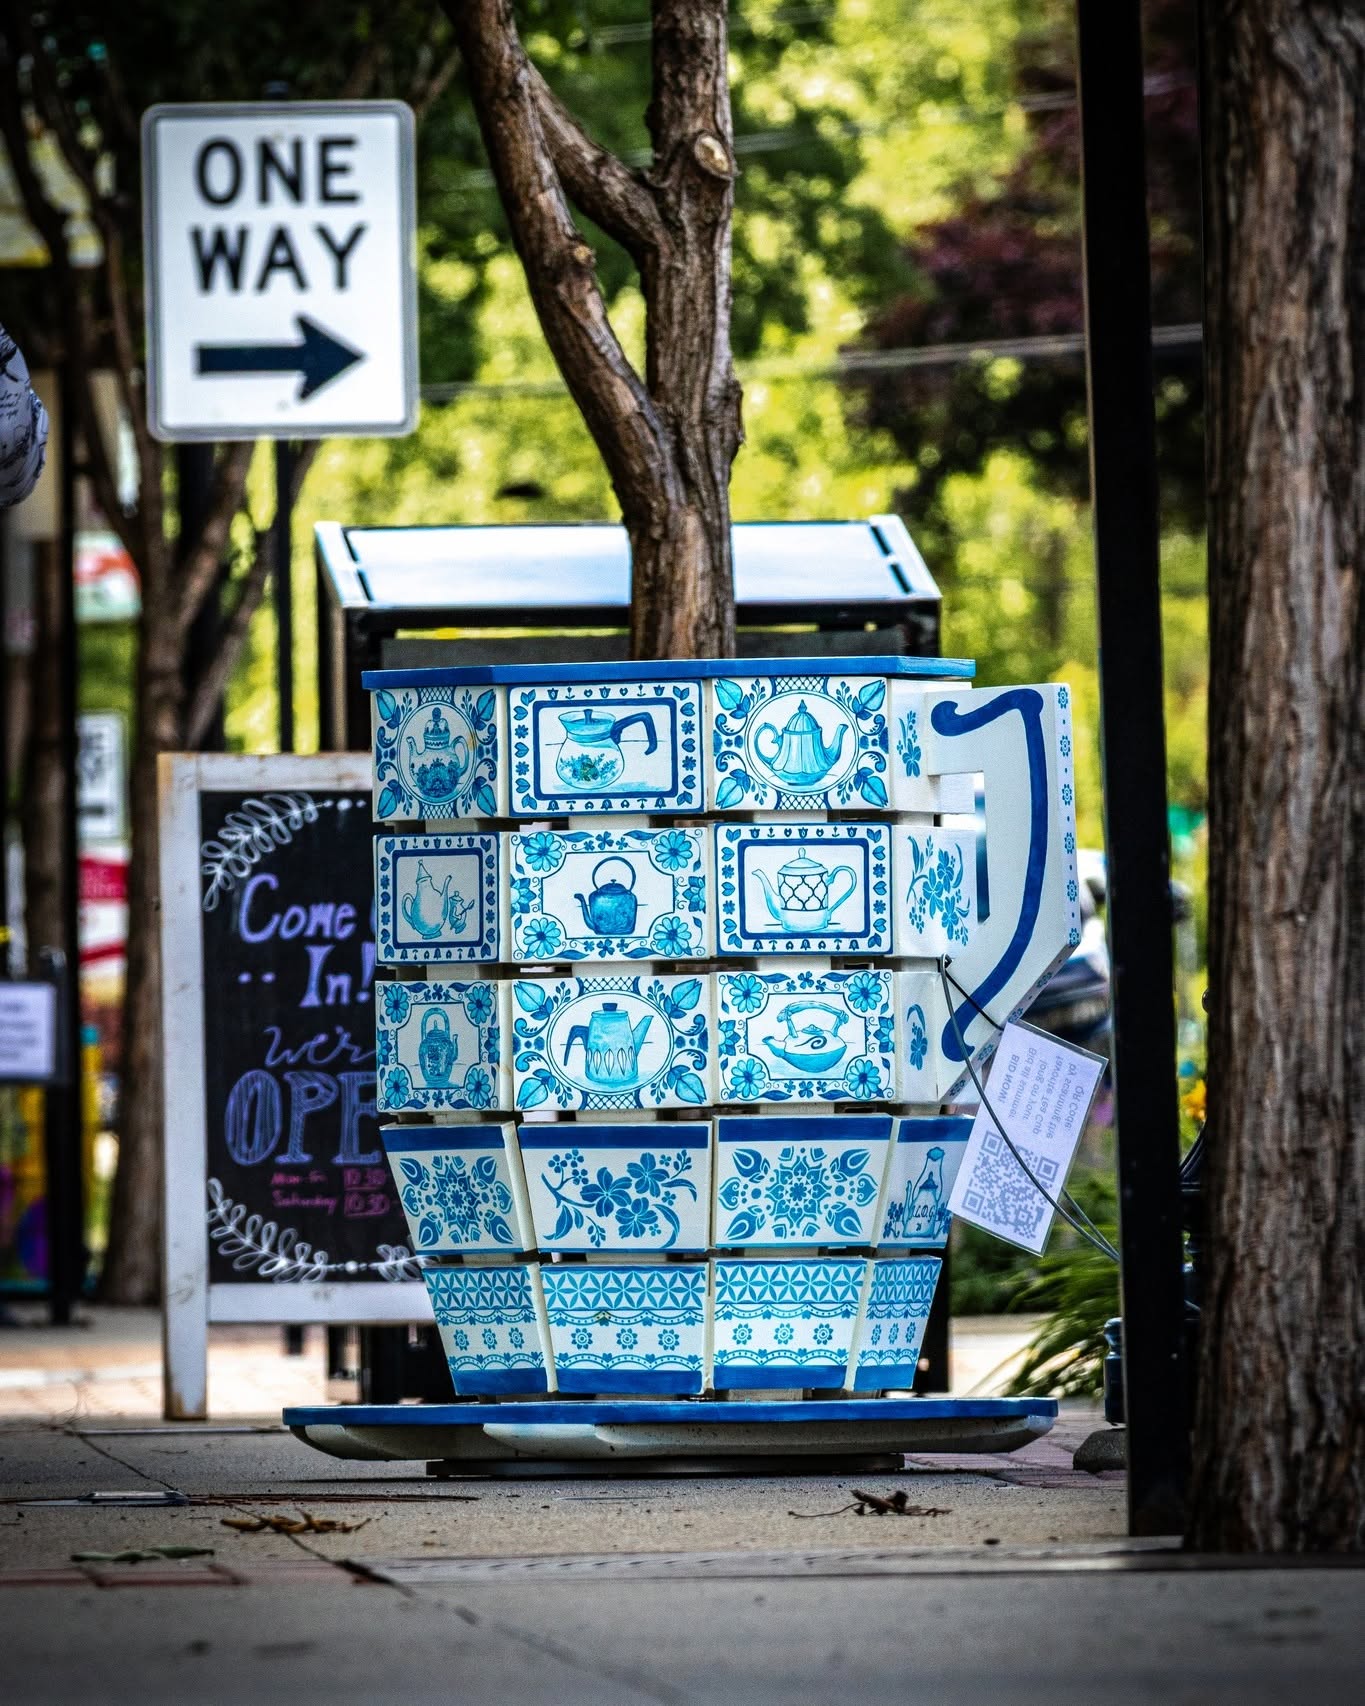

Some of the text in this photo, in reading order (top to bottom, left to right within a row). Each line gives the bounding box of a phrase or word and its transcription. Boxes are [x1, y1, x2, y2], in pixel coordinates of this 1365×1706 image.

[194, 135, 361, 207] ONE
[190, 221, 366, 293] WAY
[239, 873, 356, 943] Come
[300, 941, 375, 1007] In!
[224, 1069, 382, 1165] OPE
